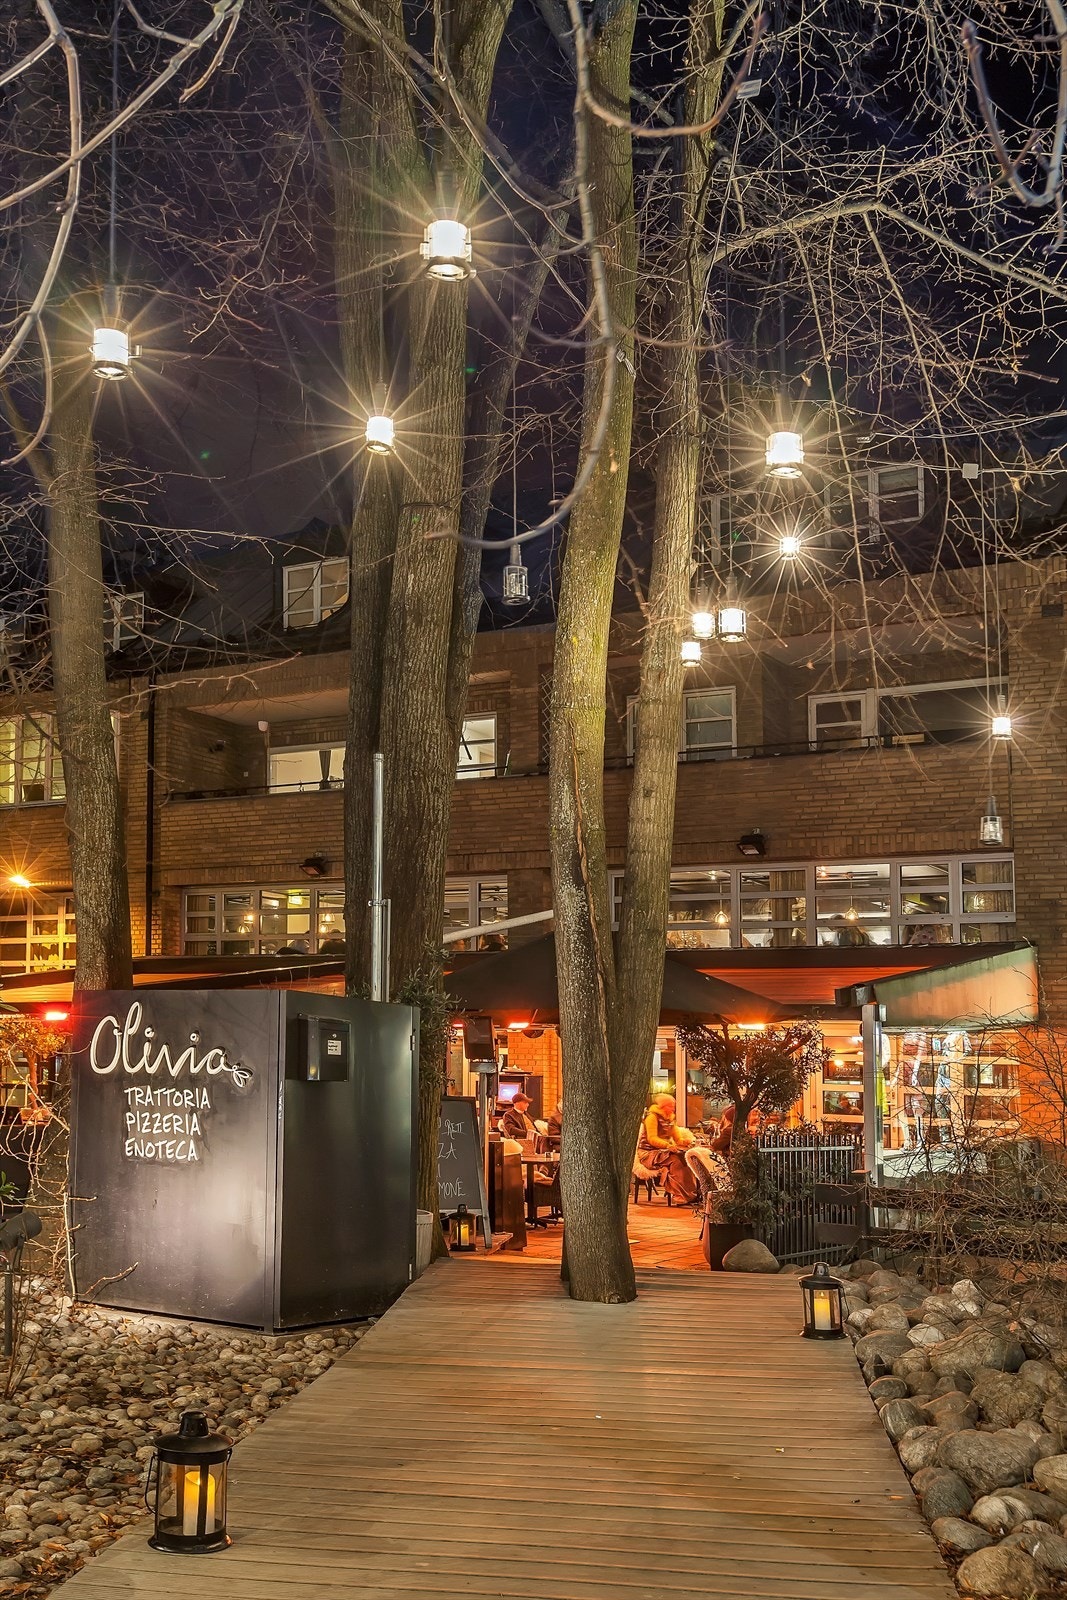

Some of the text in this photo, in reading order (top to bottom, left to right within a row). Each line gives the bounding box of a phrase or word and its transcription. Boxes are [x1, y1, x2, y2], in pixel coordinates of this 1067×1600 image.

[90, 1001, 234, 1077] Olivia
[124, 1085, 211, 1109] TRATTORIA
[125, 1111, 201, 1136] PIZZERIA
[125, 1137, 199, 1161] ENOTECA
